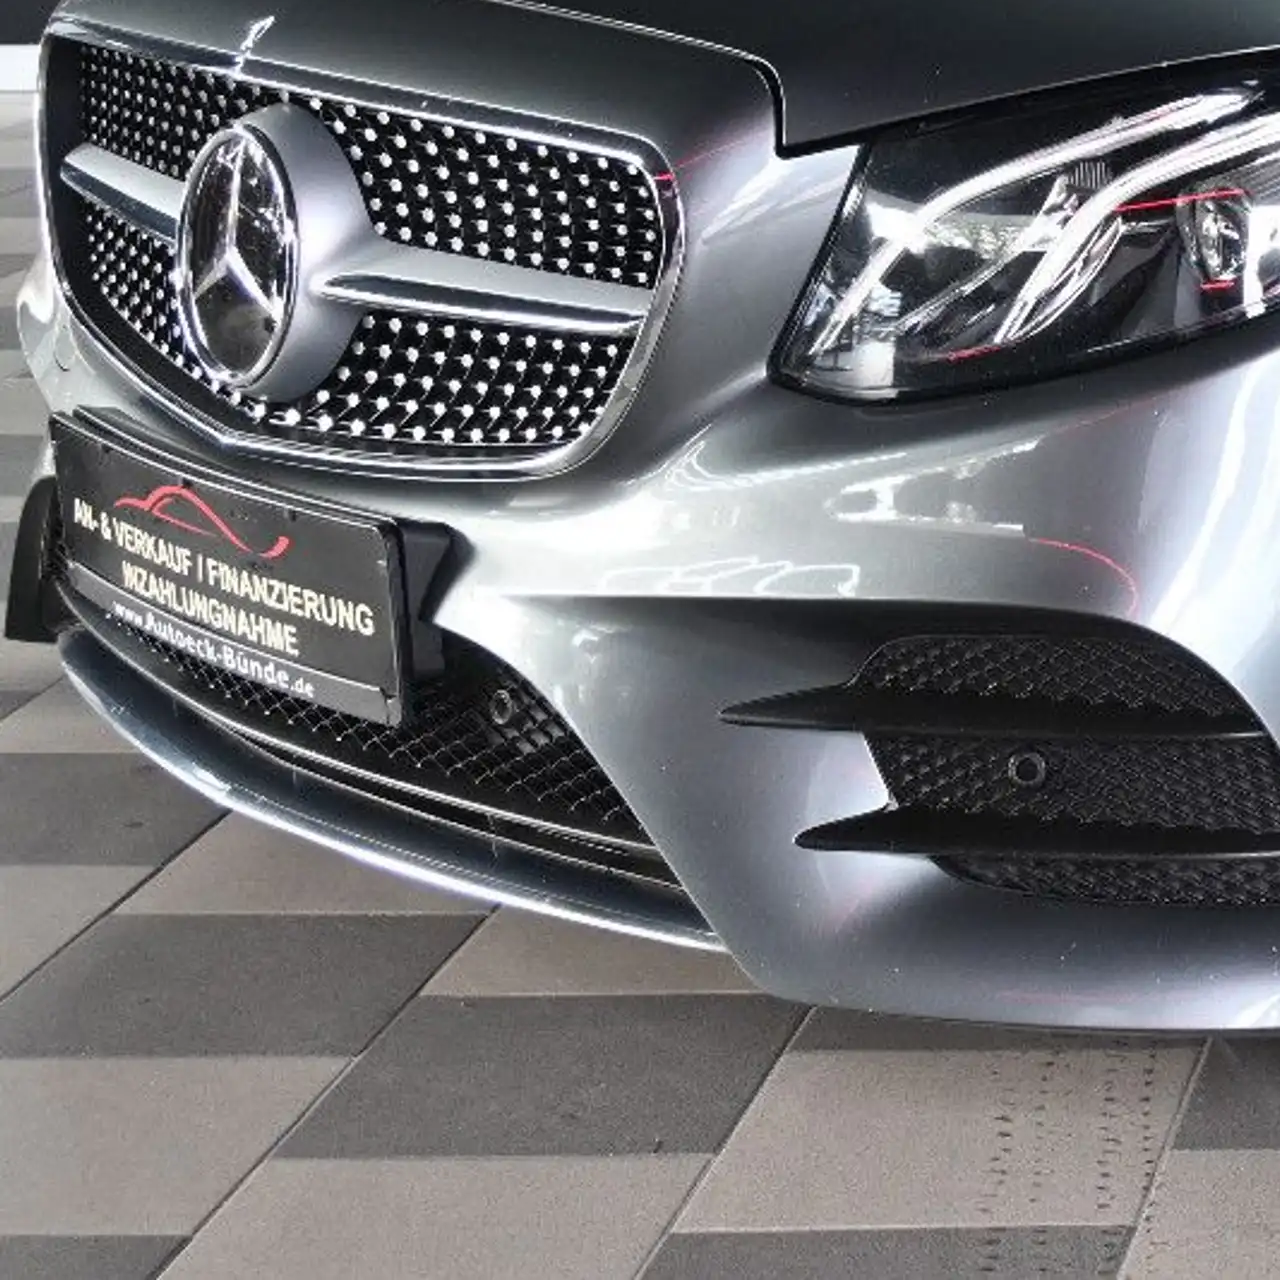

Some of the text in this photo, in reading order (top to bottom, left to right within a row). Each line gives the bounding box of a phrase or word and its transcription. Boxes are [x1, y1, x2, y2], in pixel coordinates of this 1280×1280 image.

[100, 511, 112, 541] &
[112, 516, 193, 576] VERKAUF
[205, 556, 377, 637] FINANZIERUNG
